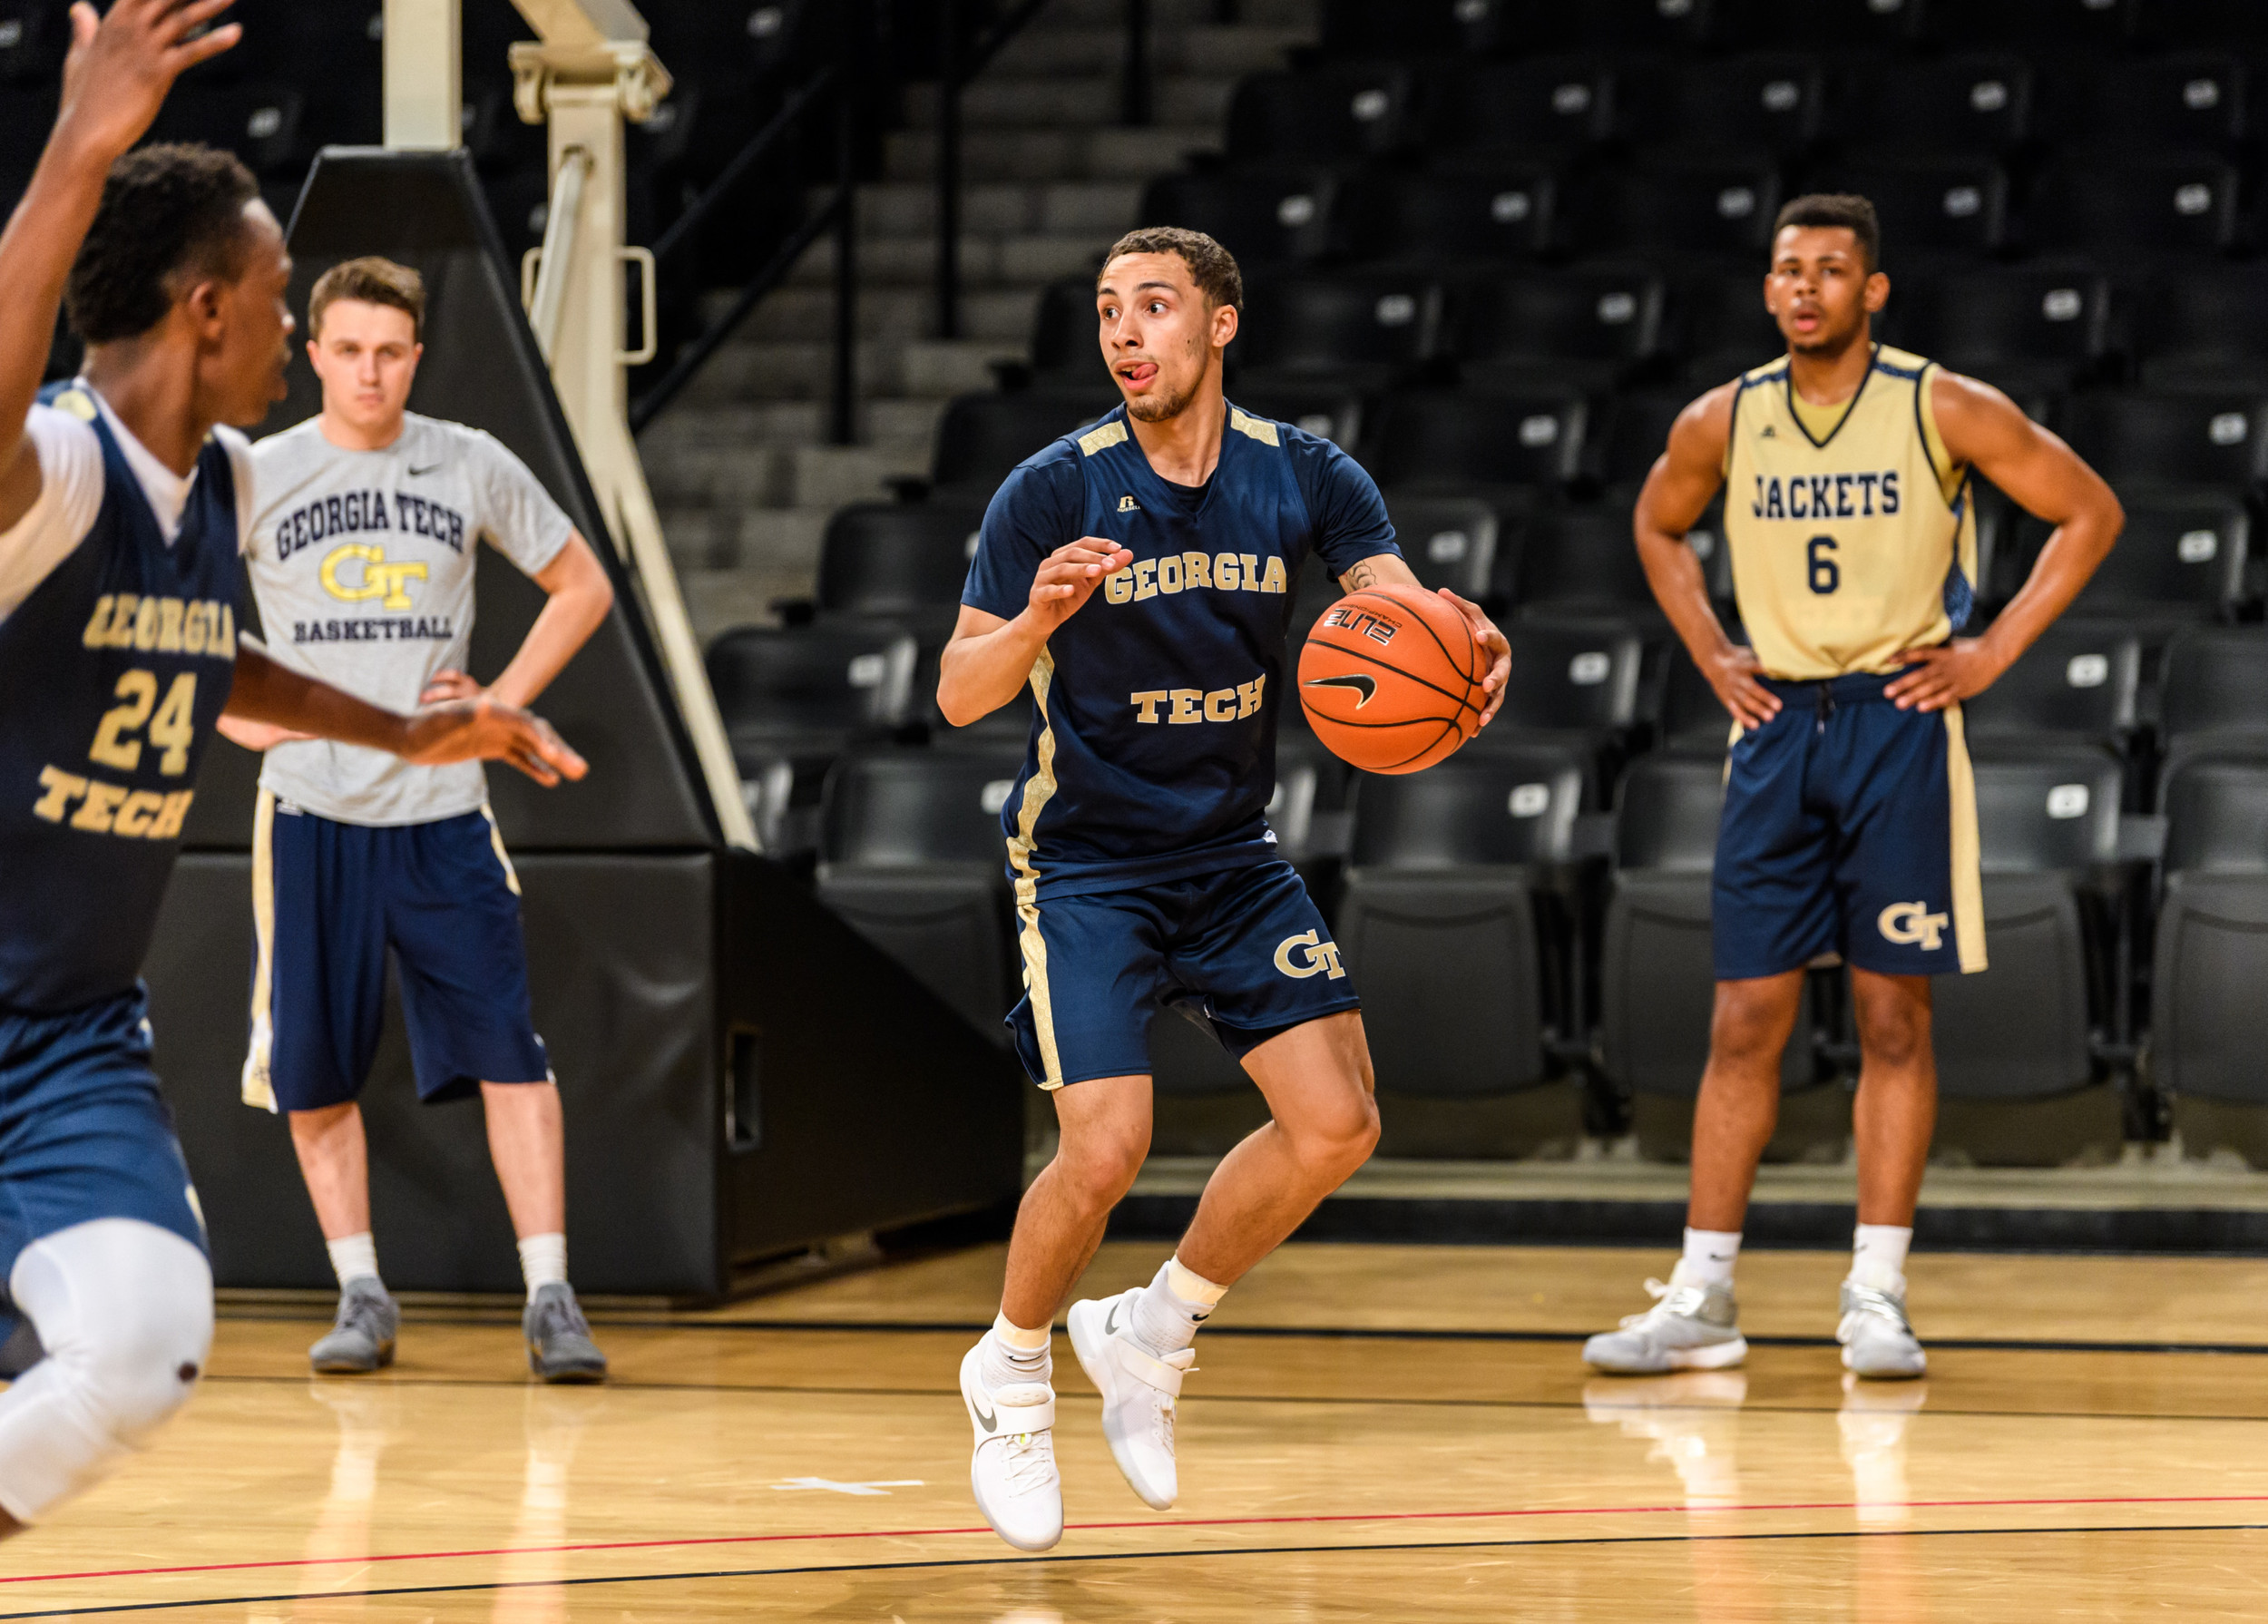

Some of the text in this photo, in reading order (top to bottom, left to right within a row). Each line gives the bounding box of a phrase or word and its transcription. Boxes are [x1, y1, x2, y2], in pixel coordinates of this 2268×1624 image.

[1751, 469, 1900, 519] JACKETS
[276, 488, 464, 562] GEORGIA TECH
[319, 542, 428, 611] GT
[1104, 552, 1287, 604] GEORGIA
[1807, 533, 1840, 595] 6
[293, 616, 453, 641] BASKETBALL
[1323, 608, 1398, 646] ELITE
[89, 668, 198, 776] 24
[1130, 672, 1266, 724] TECH
[34, 764, 193, 838] TECH
[1877, 900, 1949, 951] GT
